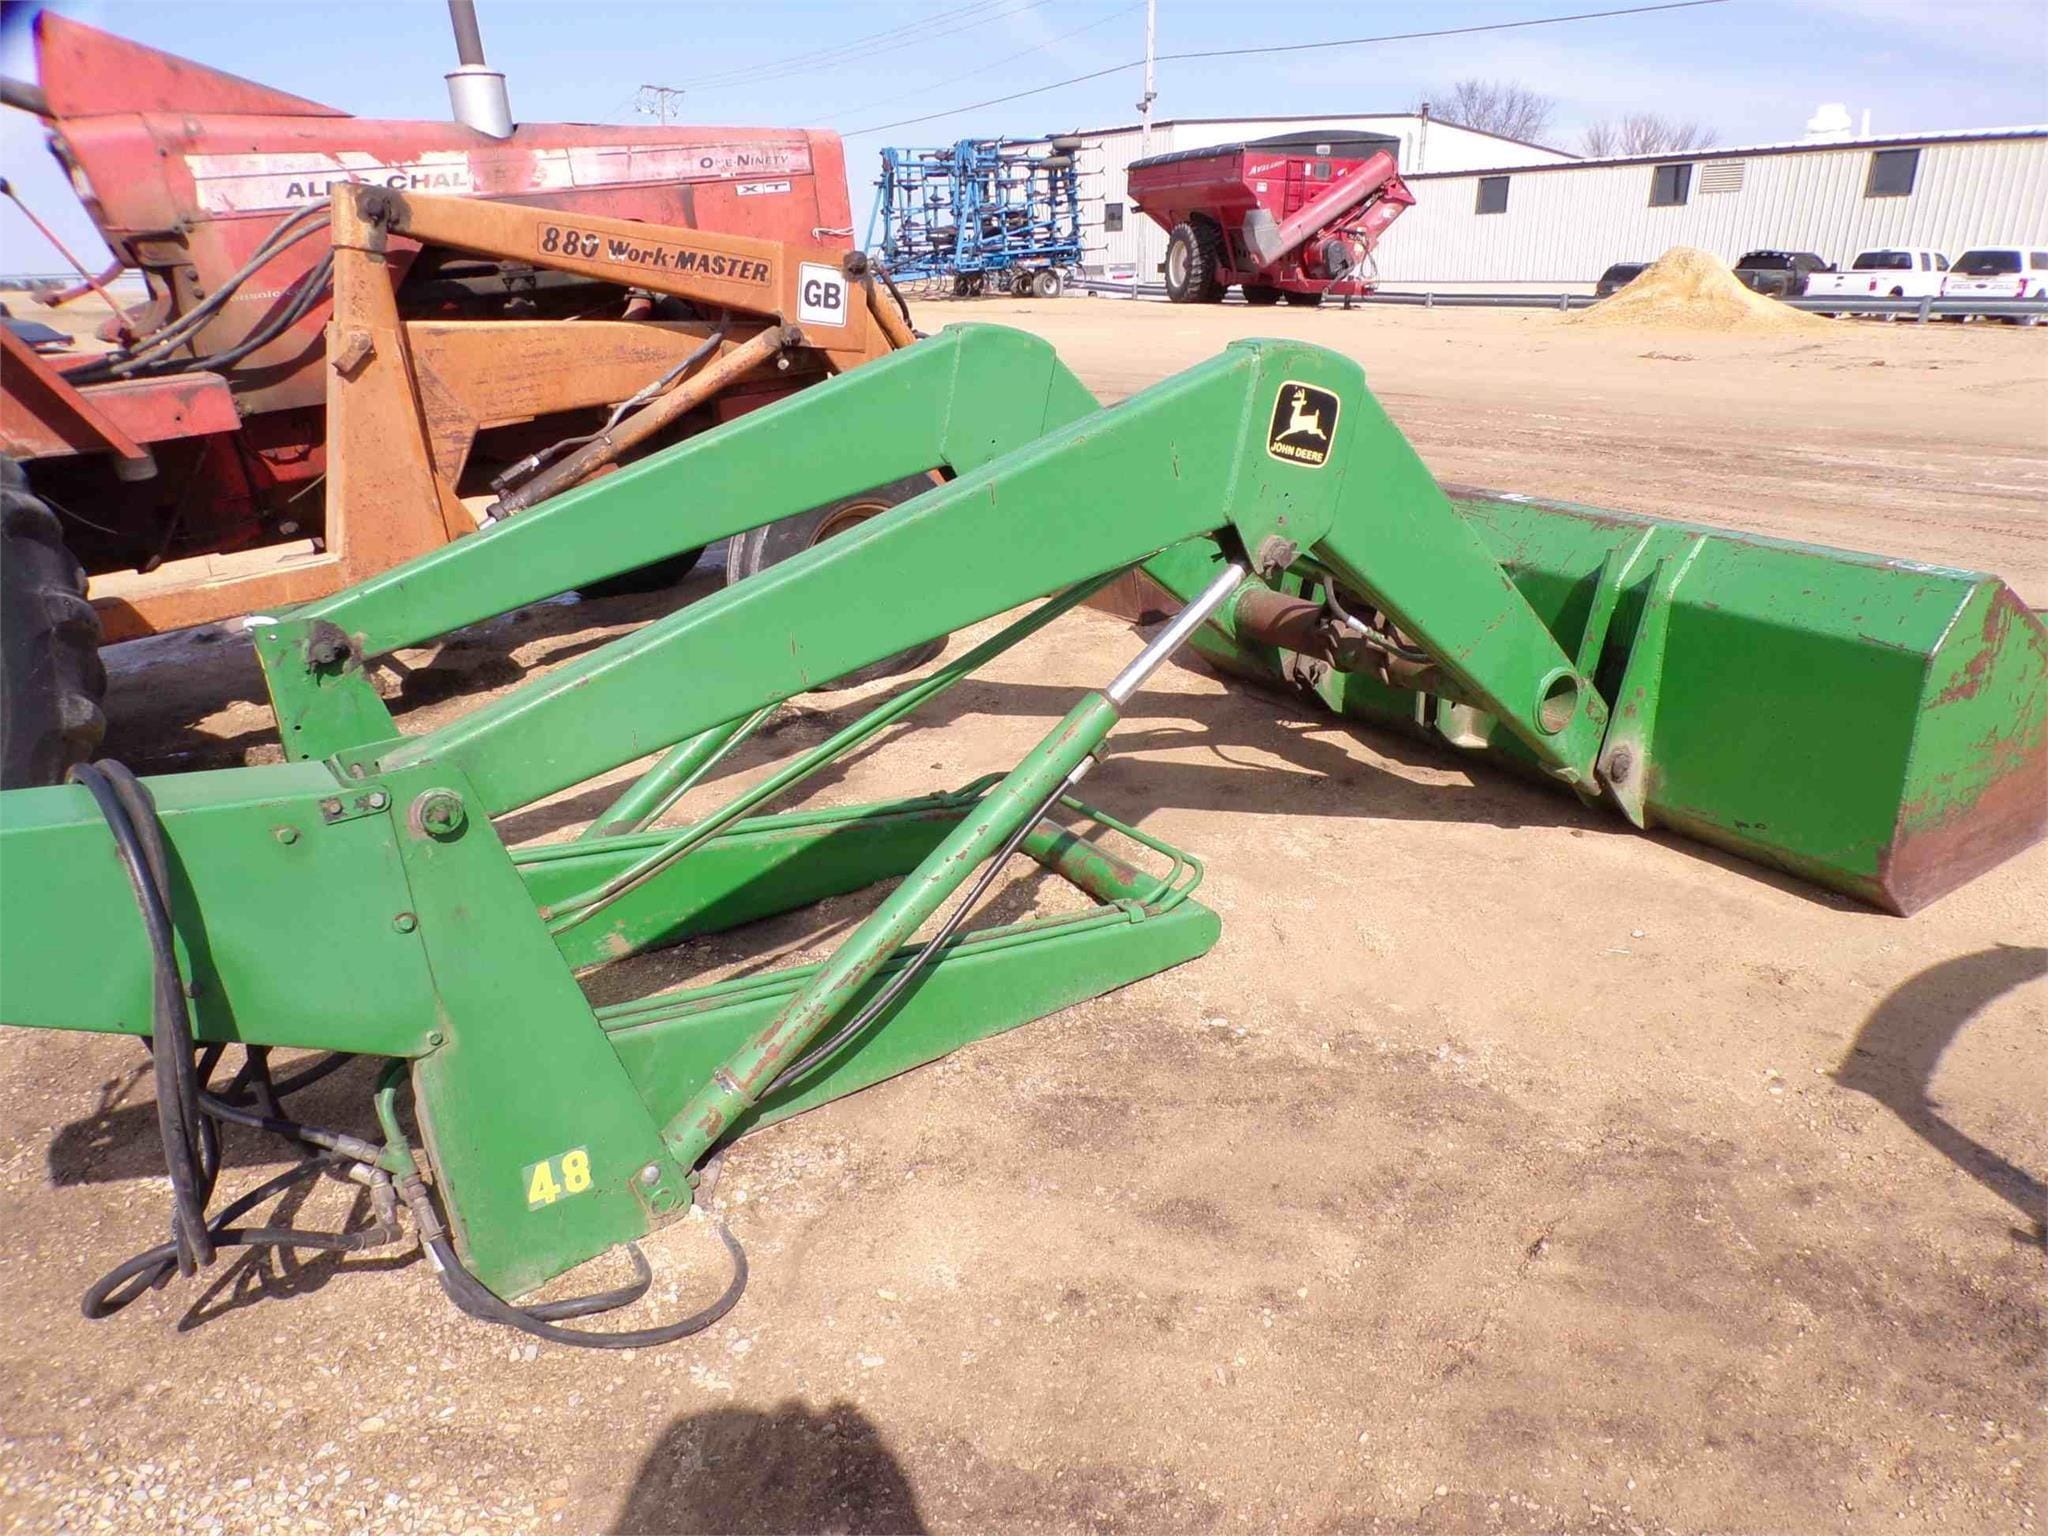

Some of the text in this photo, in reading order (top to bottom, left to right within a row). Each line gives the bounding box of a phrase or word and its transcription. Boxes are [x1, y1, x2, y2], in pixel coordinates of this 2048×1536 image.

[742, 183, 788, 194] XT
[542, 227, 600, 258] 880
[804, 279, 841, 310] GB
[1270, 441, 1324, 463] JOHN DEERE
[528, 1150, 592, 1205] 48
